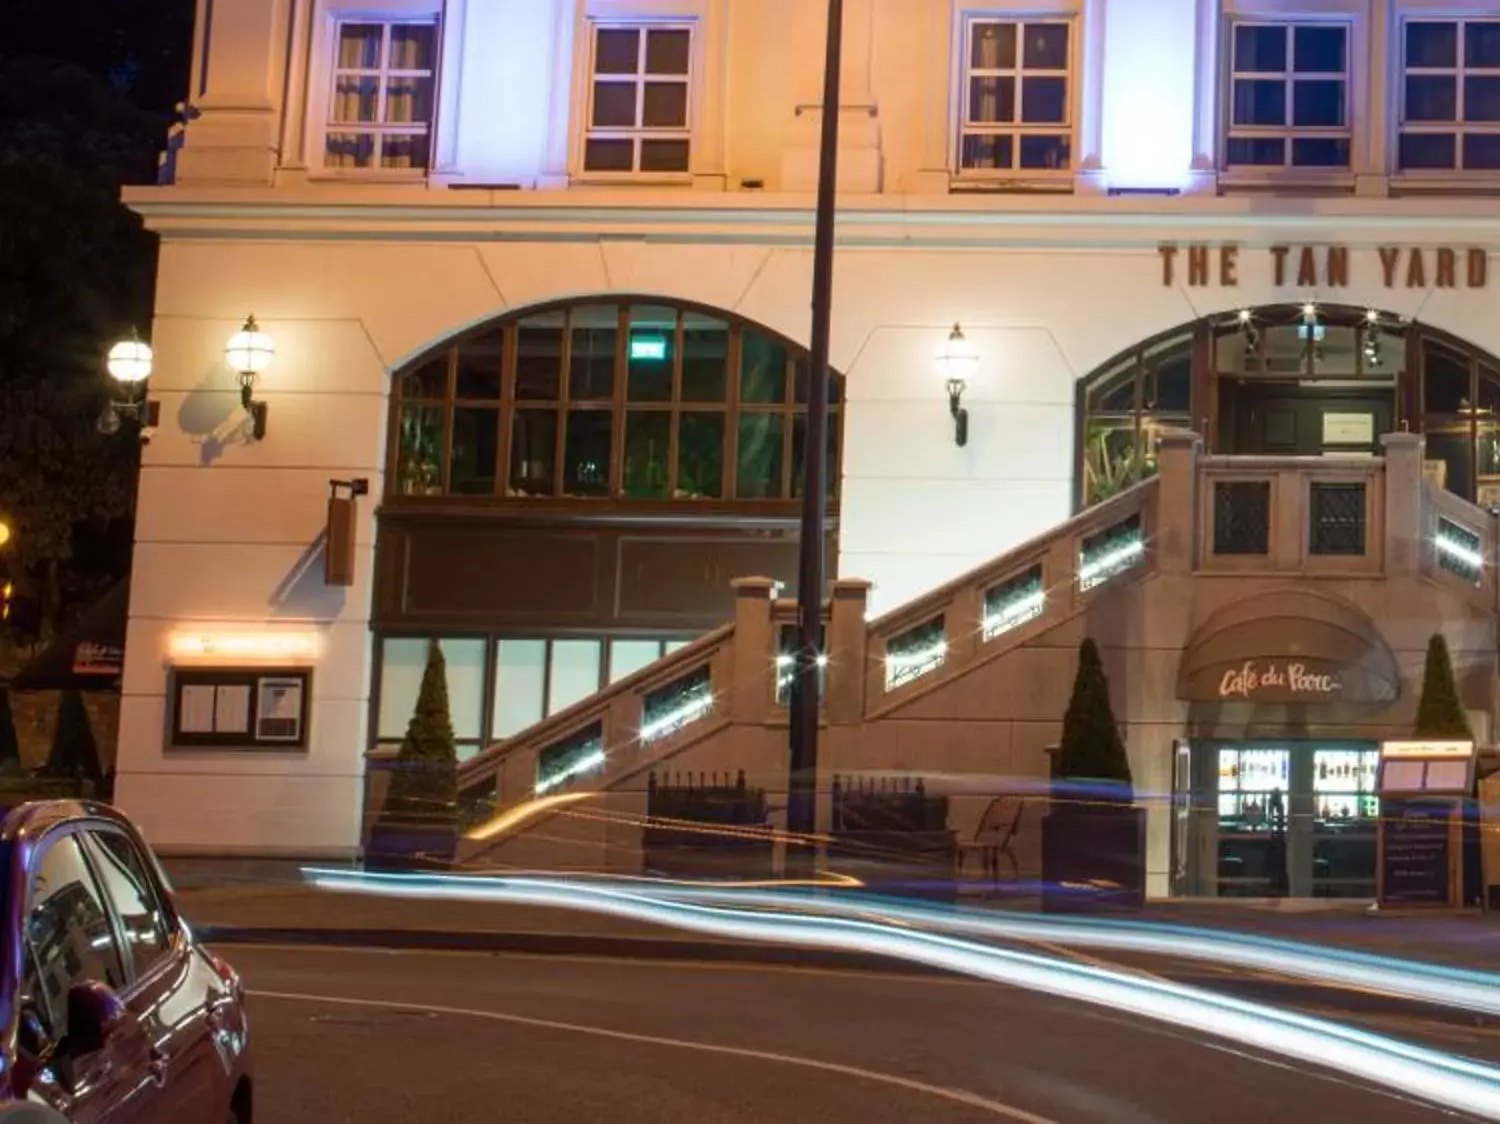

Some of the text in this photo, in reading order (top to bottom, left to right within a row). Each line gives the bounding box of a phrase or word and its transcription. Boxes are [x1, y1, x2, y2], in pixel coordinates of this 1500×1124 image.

[1157, 245, 1487, 288] THE TAN YARD
[1261, 665, 1284, 686] du
